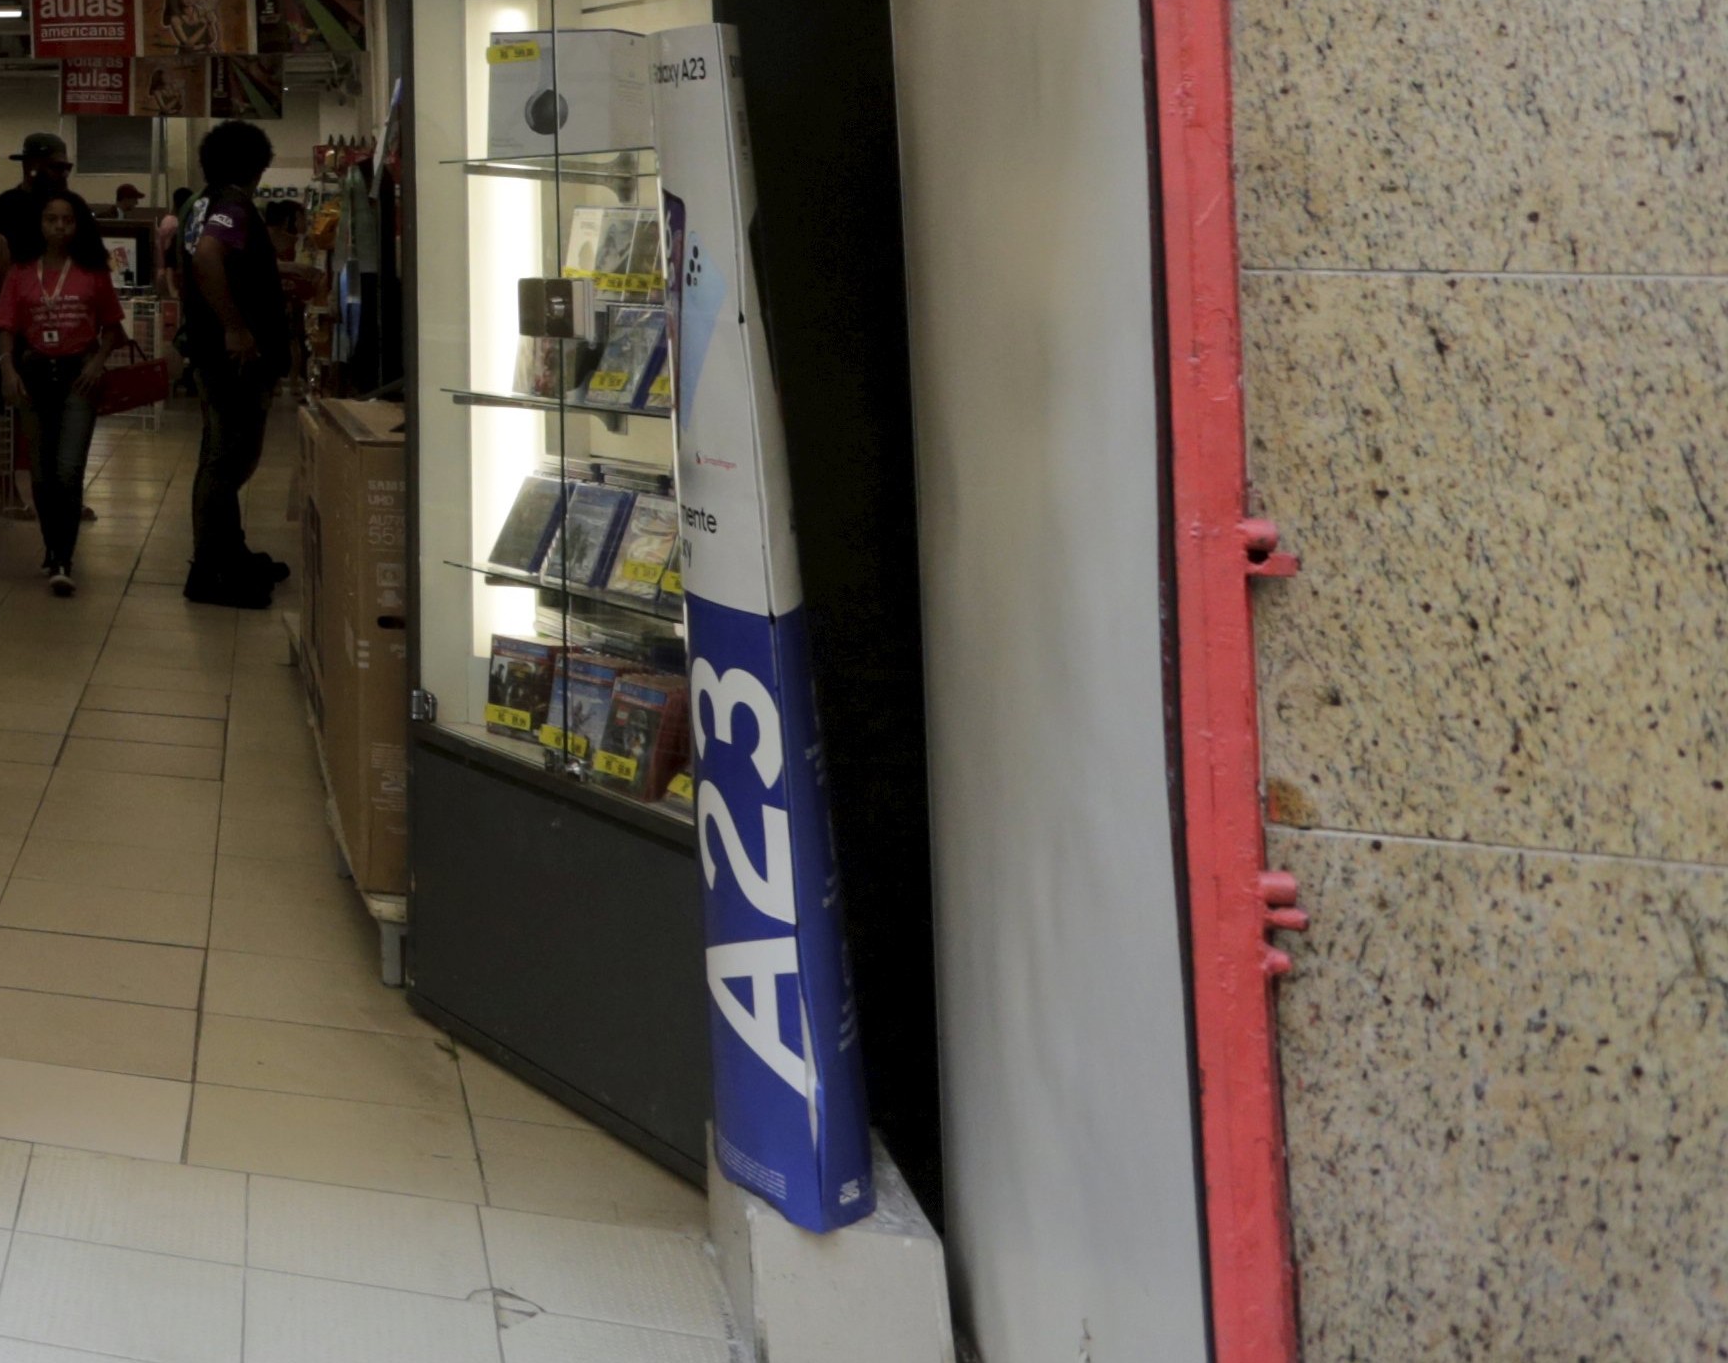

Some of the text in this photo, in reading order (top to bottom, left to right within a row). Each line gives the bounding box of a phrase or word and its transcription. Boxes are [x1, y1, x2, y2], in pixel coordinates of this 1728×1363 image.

[41, 24, 125, 38] americanas
[67, 69, 123, 88] aulas
[681, 57, 706, 81] A23
[368, 480, 406, 491] SAMS
[691, 657, 817, 1099] A23
